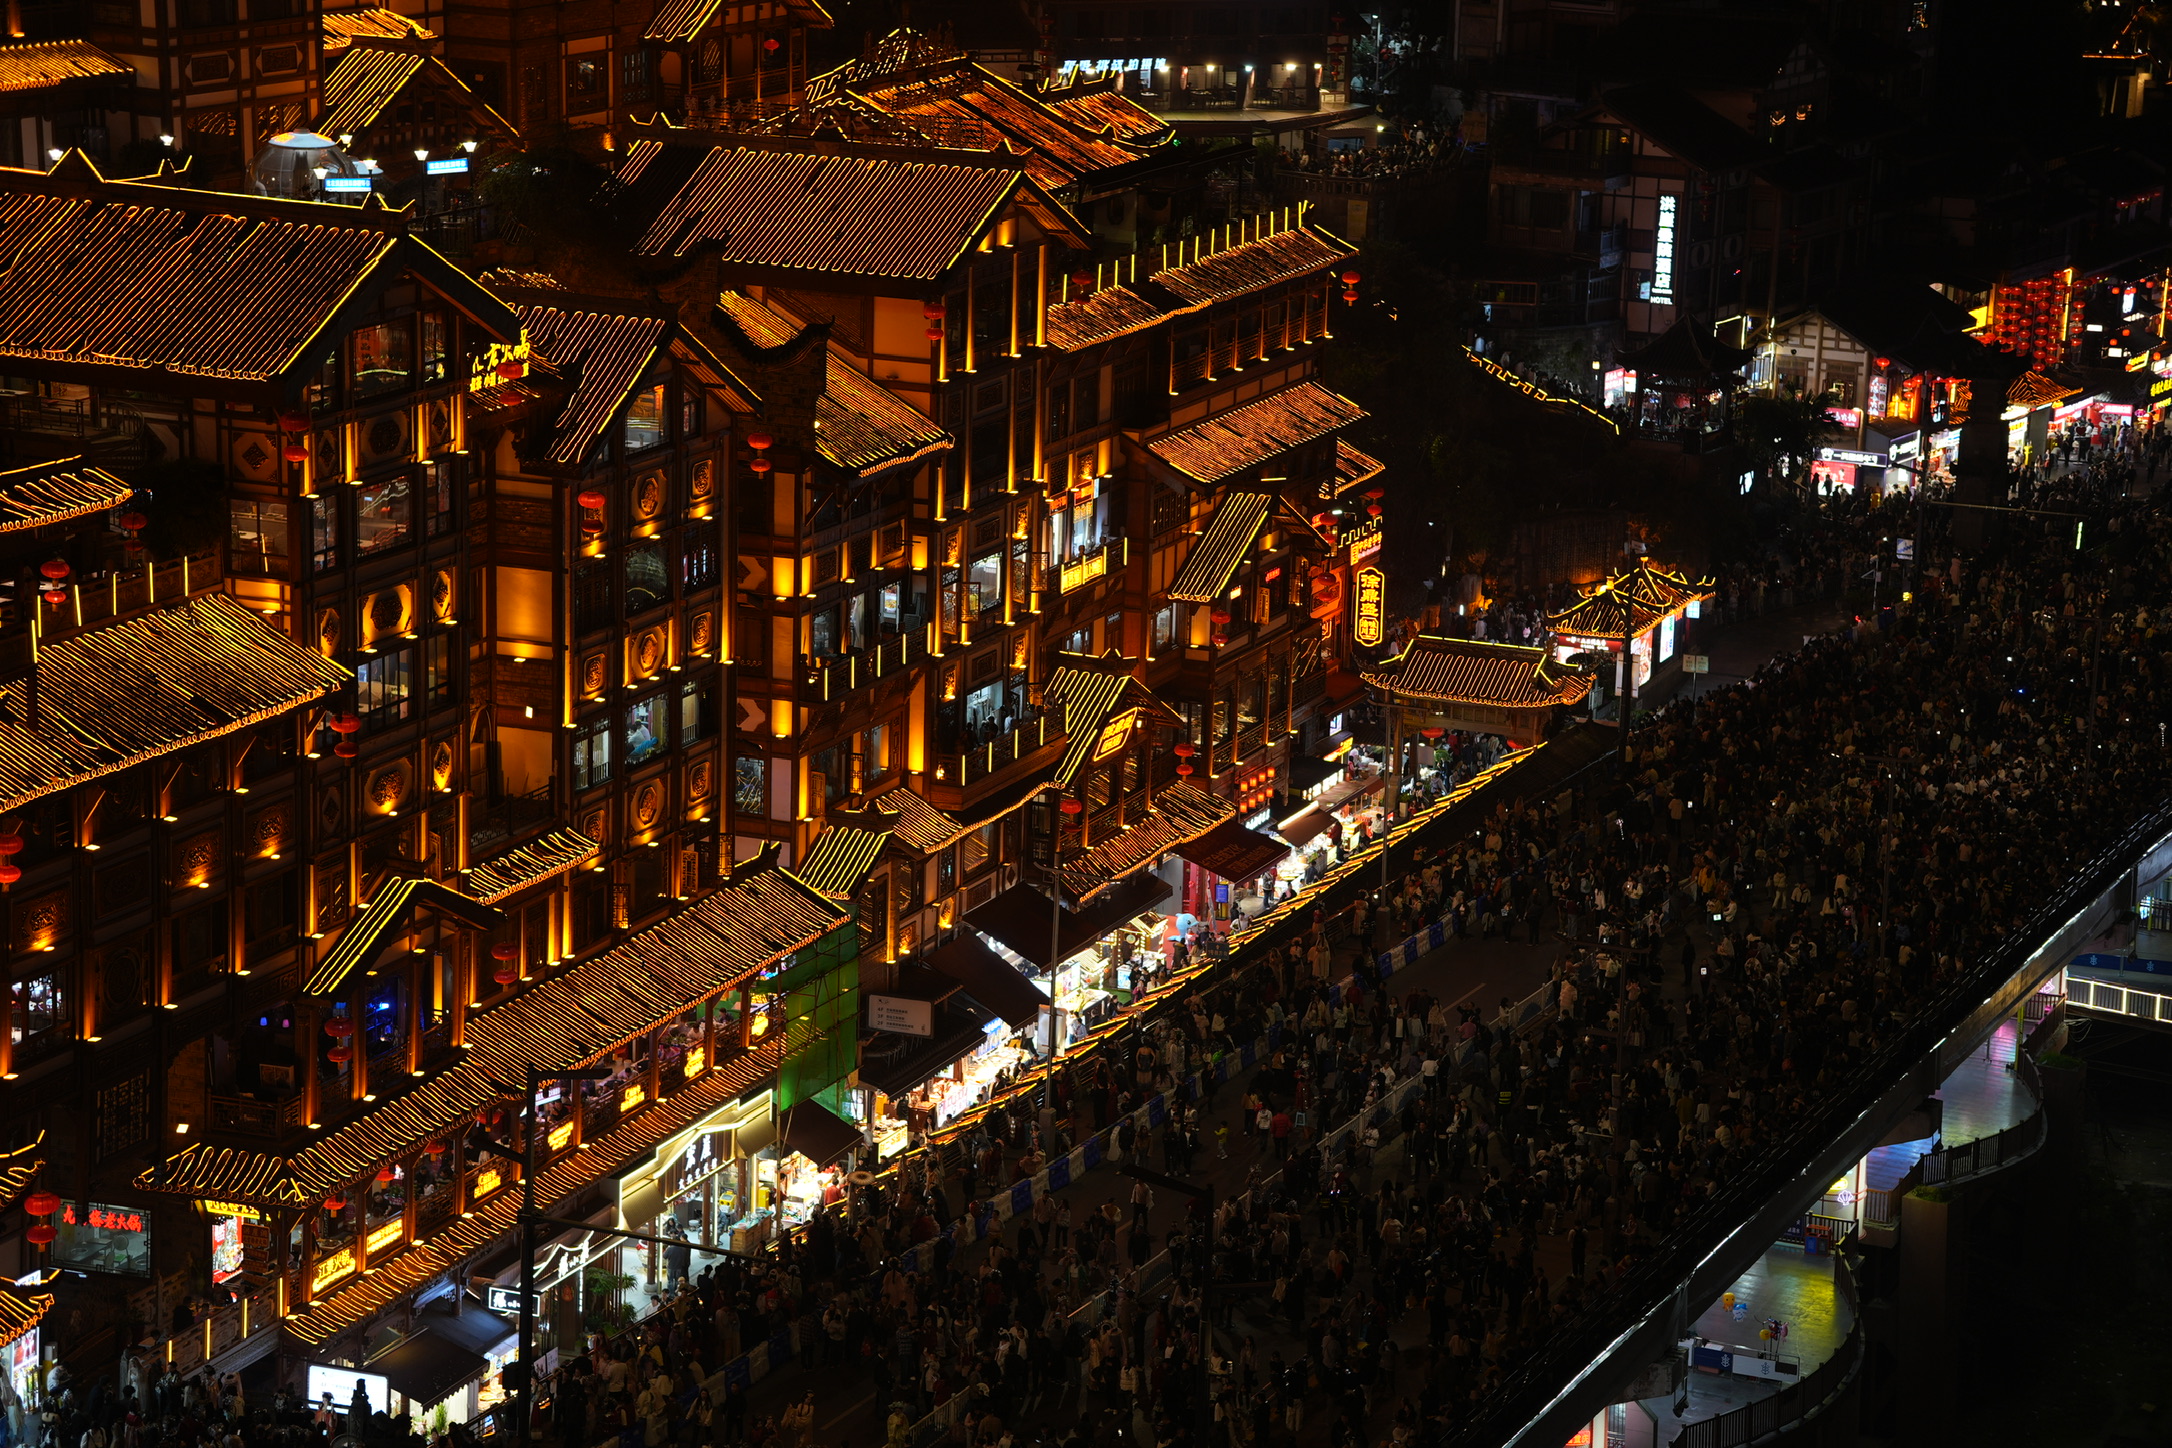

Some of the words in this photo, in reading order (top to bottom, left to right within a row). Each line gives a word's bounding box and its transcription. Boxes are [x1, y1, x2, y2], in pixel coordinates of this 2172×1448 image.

[1650, 296, 1673, 305] HOTEL
[1360, 574, 1381, 617] 徐鼎盛
